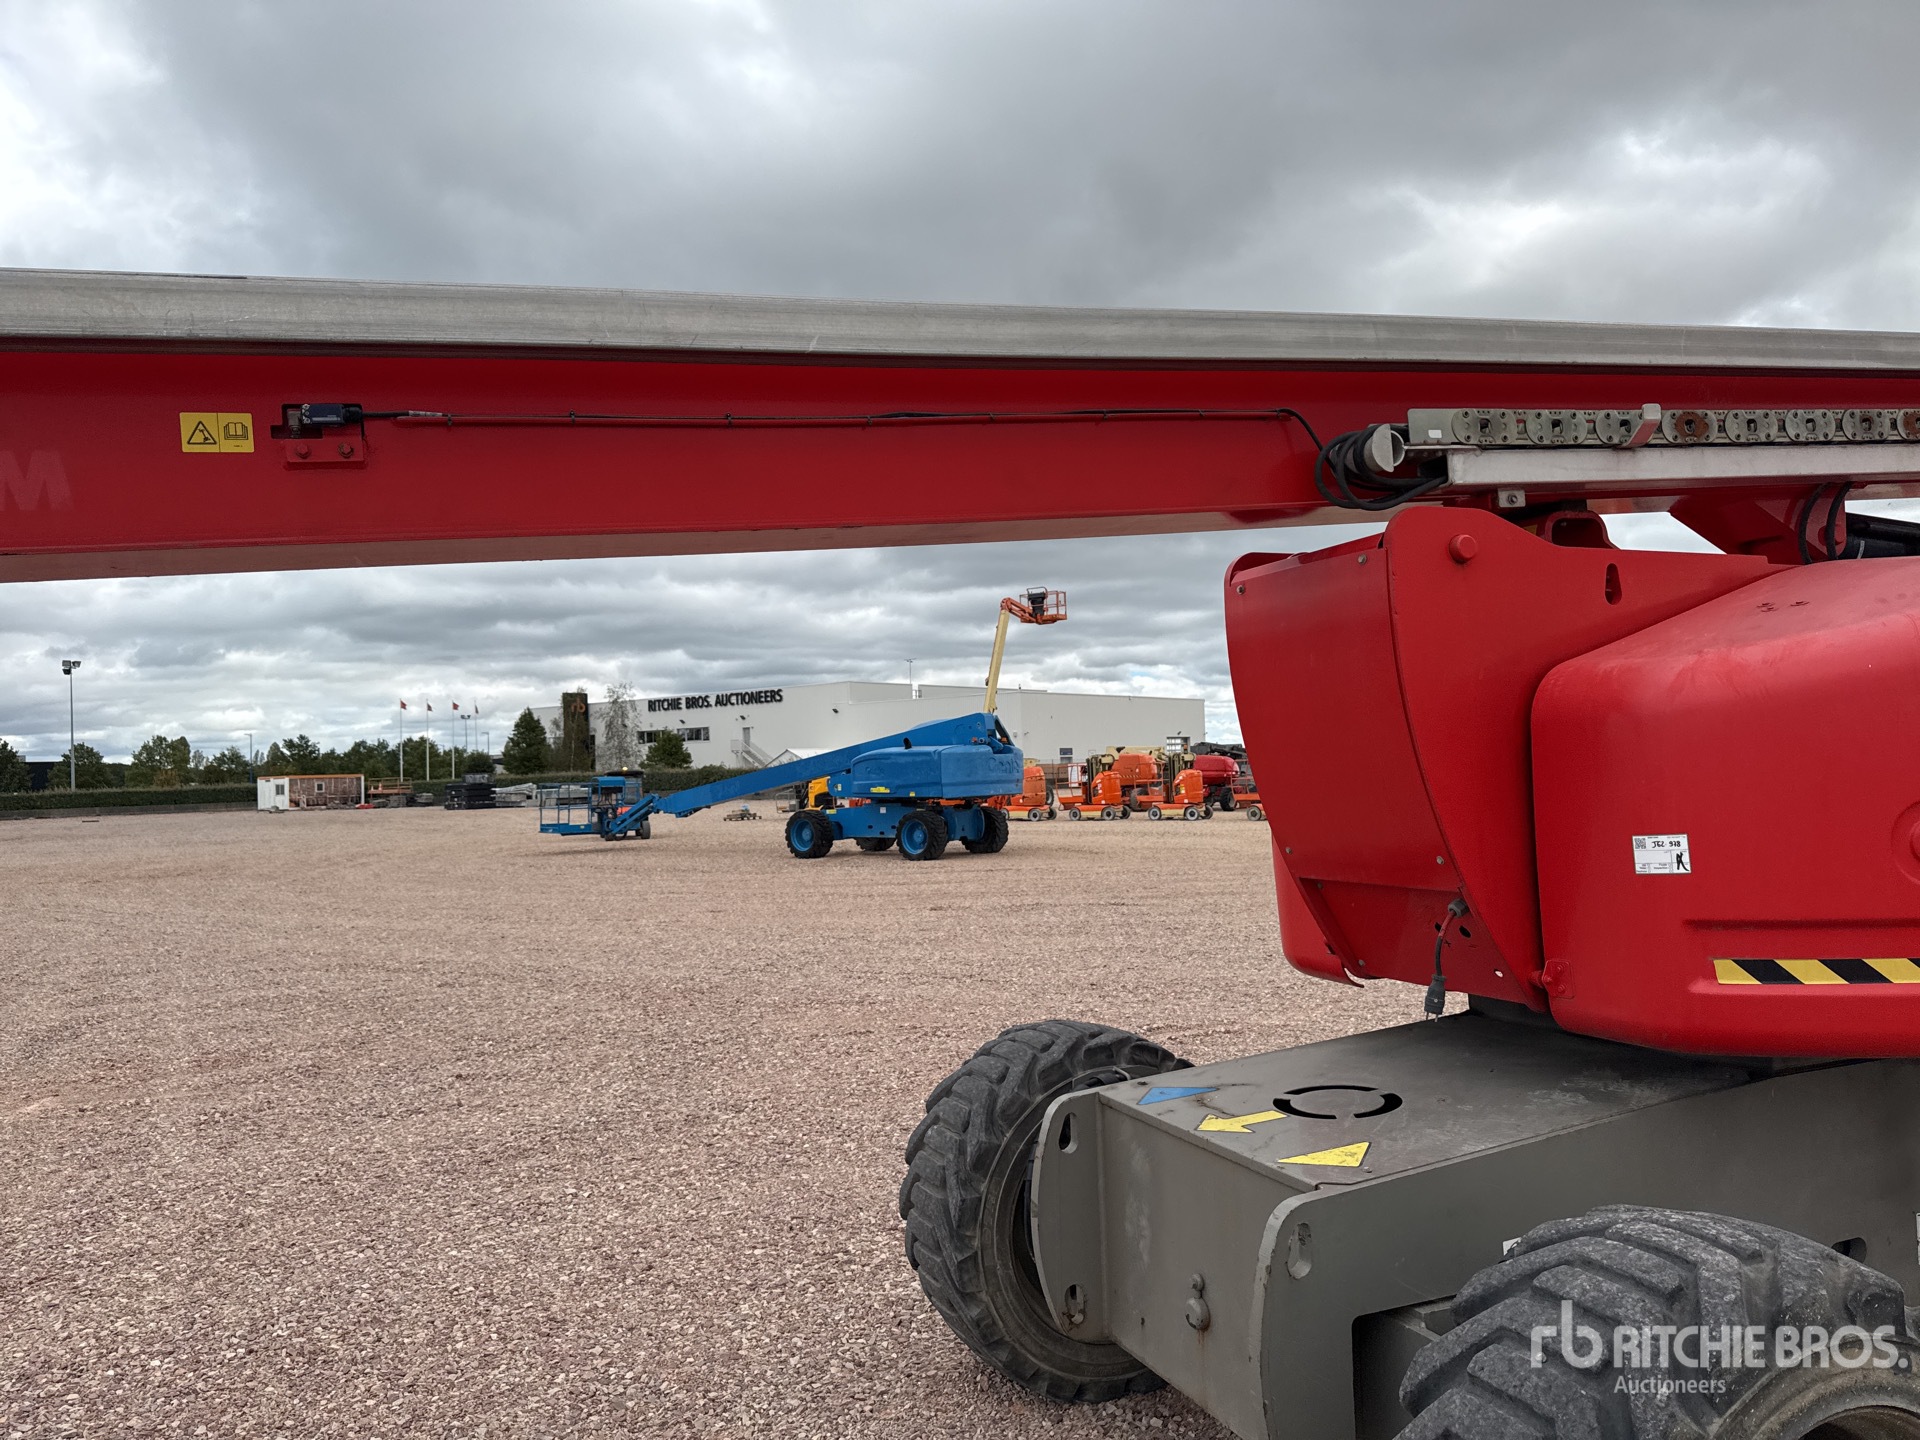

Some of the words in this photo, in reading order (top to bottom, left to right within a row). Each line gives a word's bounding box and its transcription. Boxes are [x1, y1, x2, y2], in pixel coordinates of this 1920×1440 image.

[648, 698, 682, 712] RITCHIE
[685, 695, 712, 710] BROS.
[715, 689, 783, 707] AUCTIONEERS
